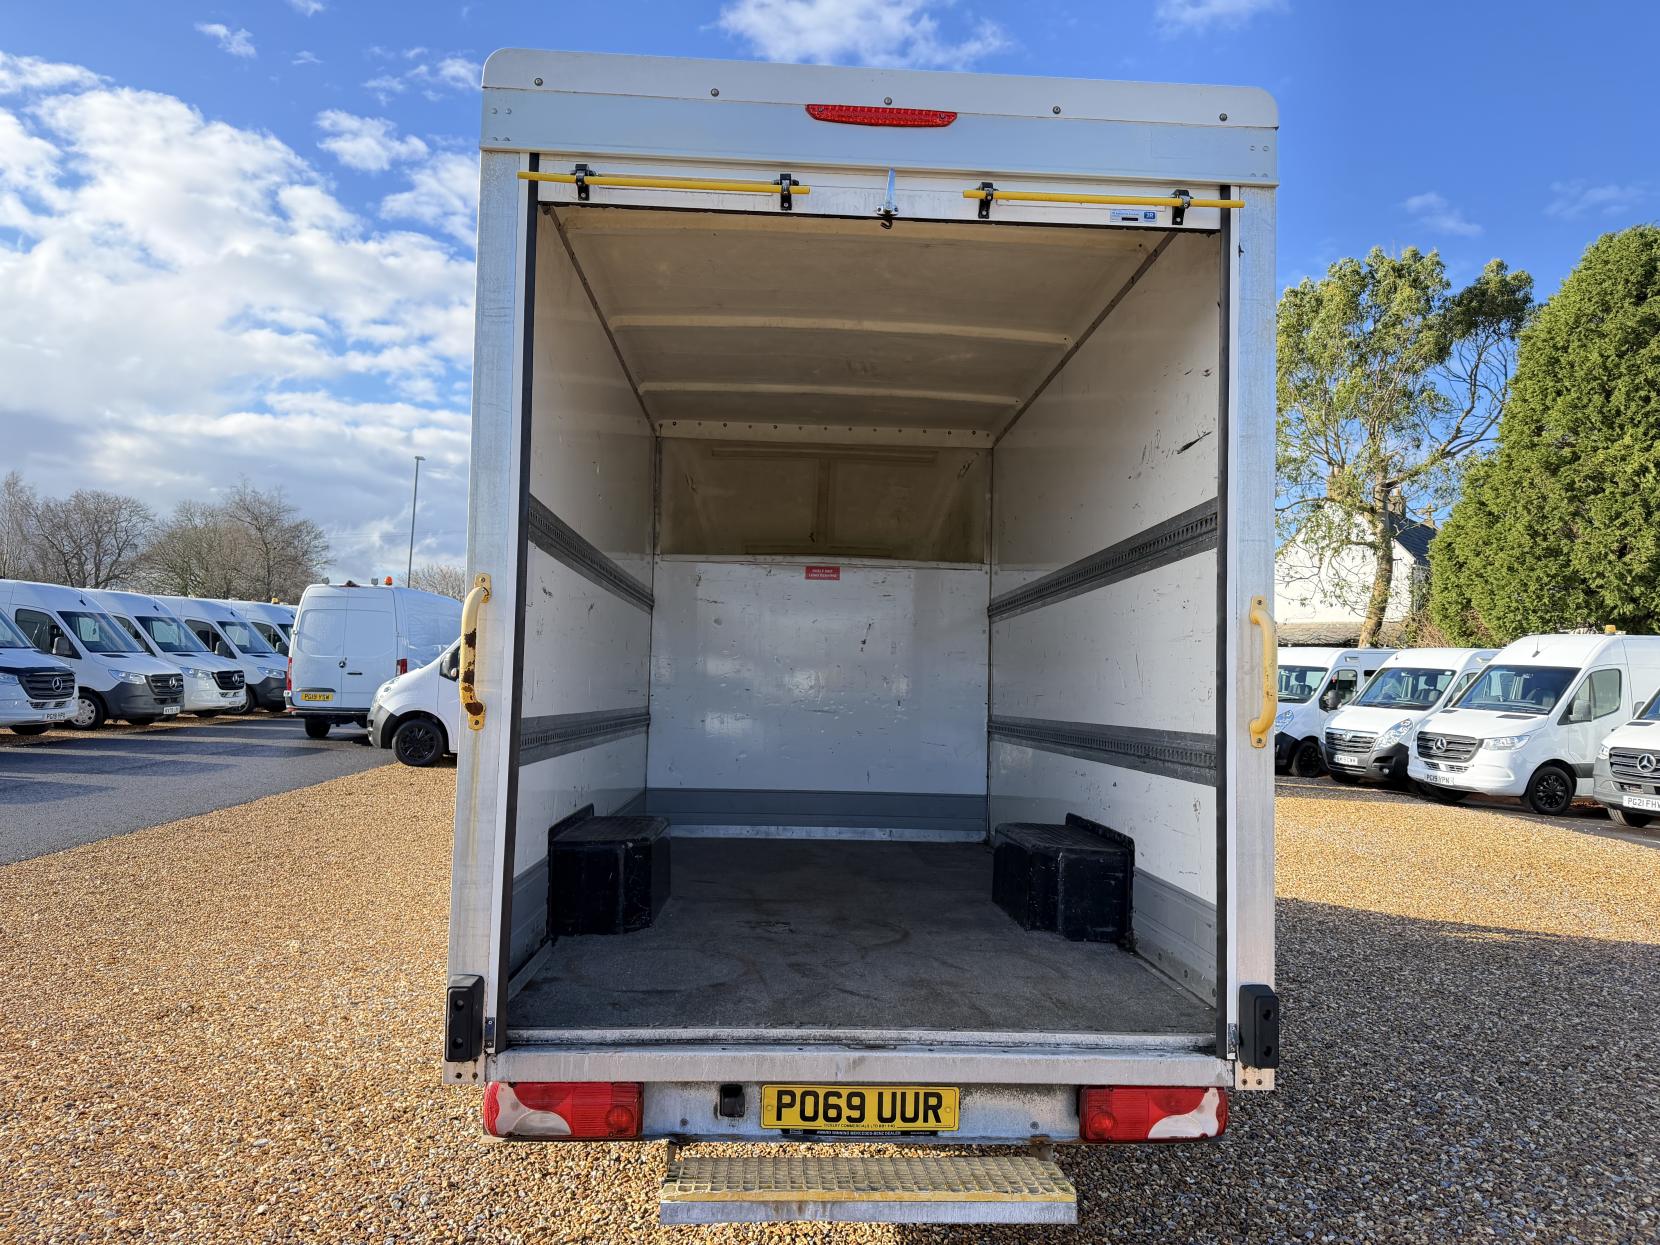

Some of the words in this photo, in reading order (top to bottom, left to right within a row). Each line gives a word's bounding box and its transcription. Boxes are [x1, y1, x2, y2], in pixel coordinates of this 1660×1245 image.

[1628, 797, 1645, 807] PG21
[776, 1090, 866, 1123] PO69
[877, 1091, 943, 1123] UUR
